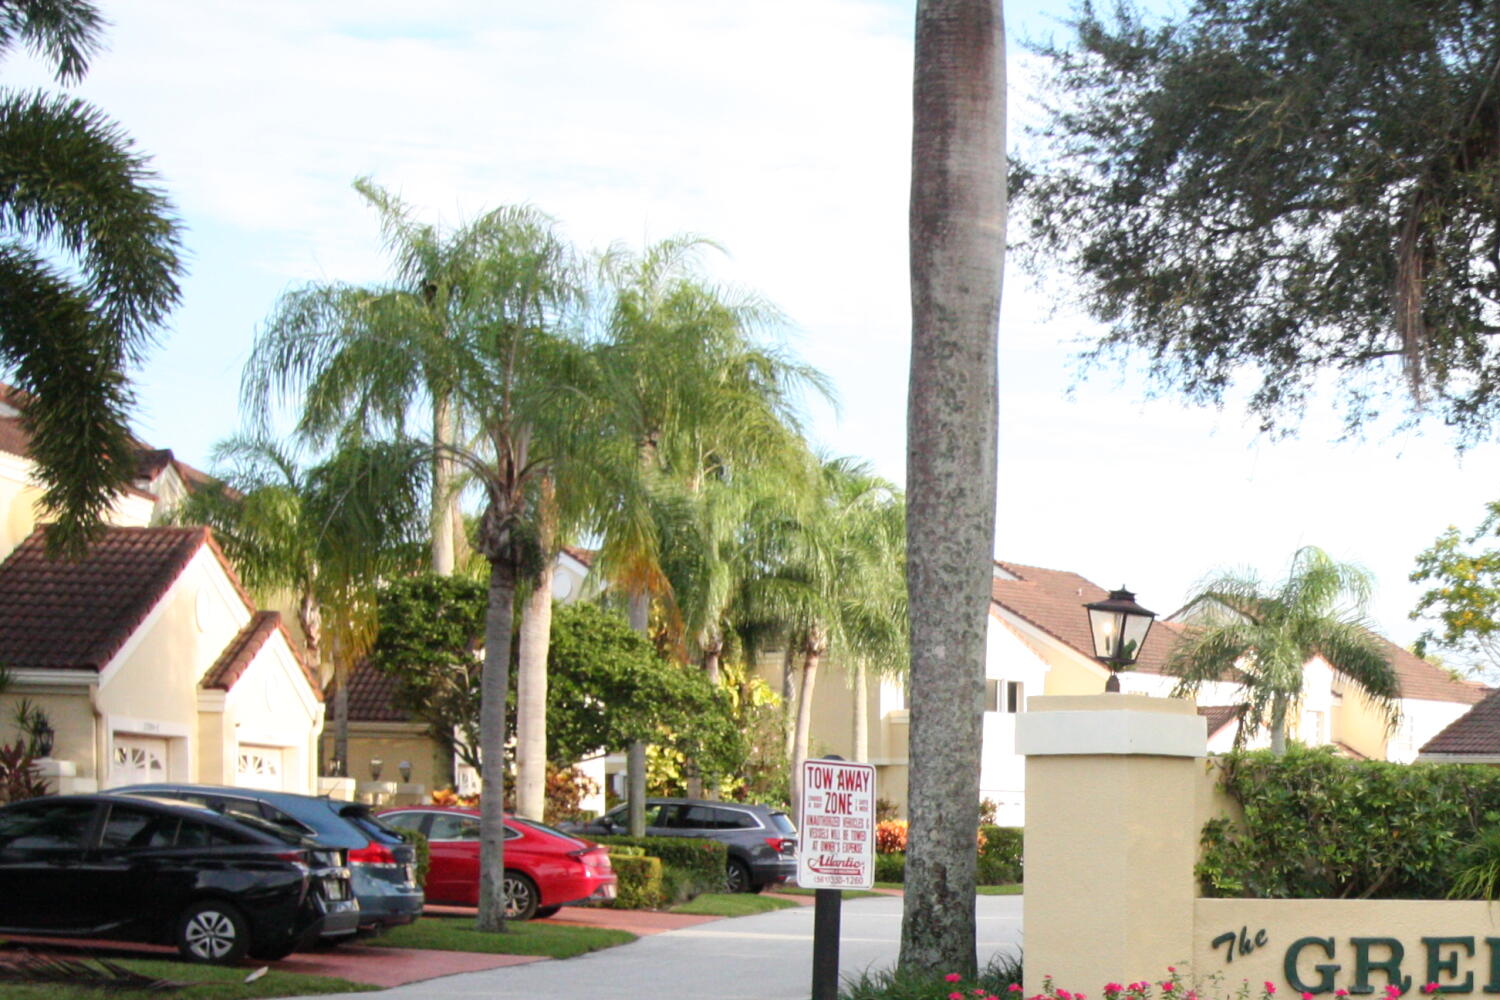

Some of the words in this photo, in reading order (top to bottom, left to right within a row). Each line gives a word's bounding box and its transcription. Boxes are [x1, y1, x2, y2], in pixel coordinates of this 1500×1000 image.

[808, 767, 833, 789] TOW
[838, 769, 870, 792] AWAY
[825, 792, 853, 815] ZONE
[812, 840, 818, 850] AT
[842, 842, 863, 853] EXPENSE
[831, 829, 840, 840] WILL
[843, 829, 848, 840] BE
[851, 830, 867, 841] TOWED
[1212, 926, 1268, 964] The
